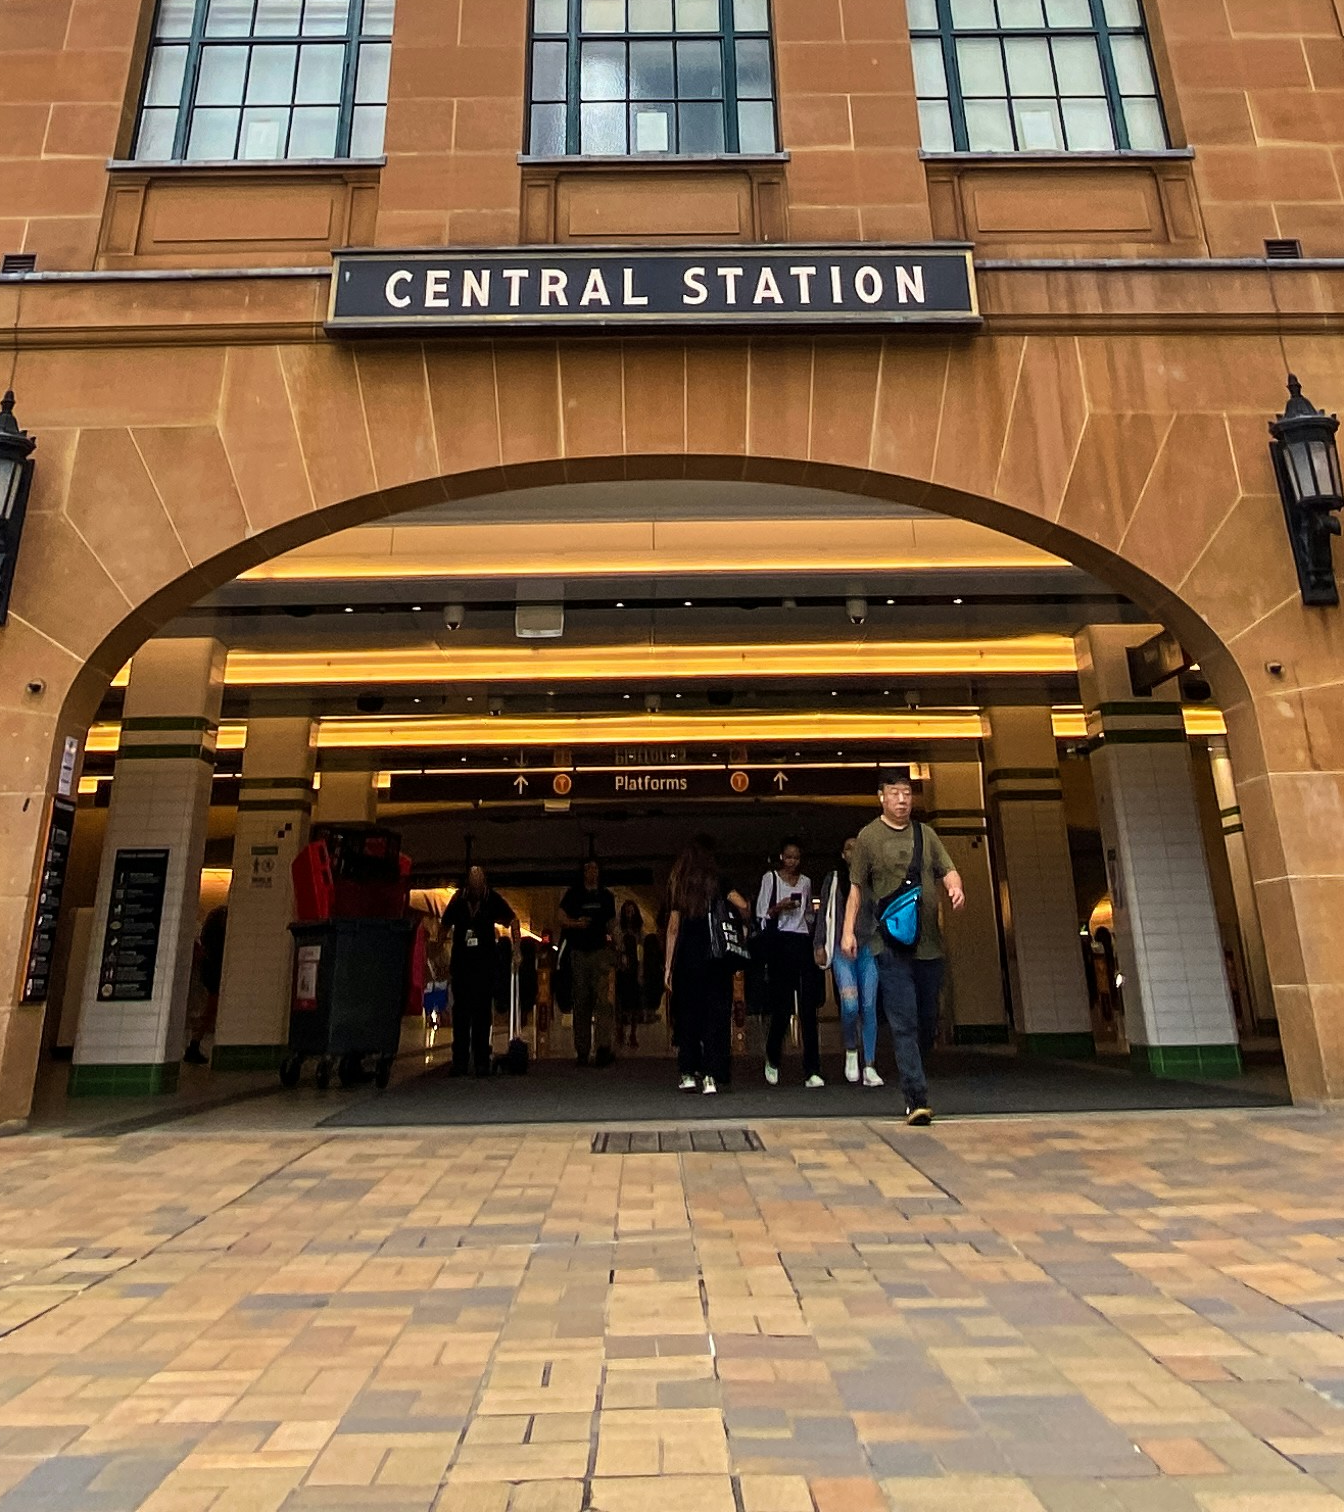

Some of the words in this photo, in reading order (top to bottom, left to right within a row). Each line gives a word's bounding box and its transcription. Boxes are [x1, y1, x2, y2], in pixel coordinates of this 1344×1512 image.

[384, 267, 649, 308] CENTRAL
[681, 265, 926, 305] STATION
[615, 775, 687, 791] Platforms
